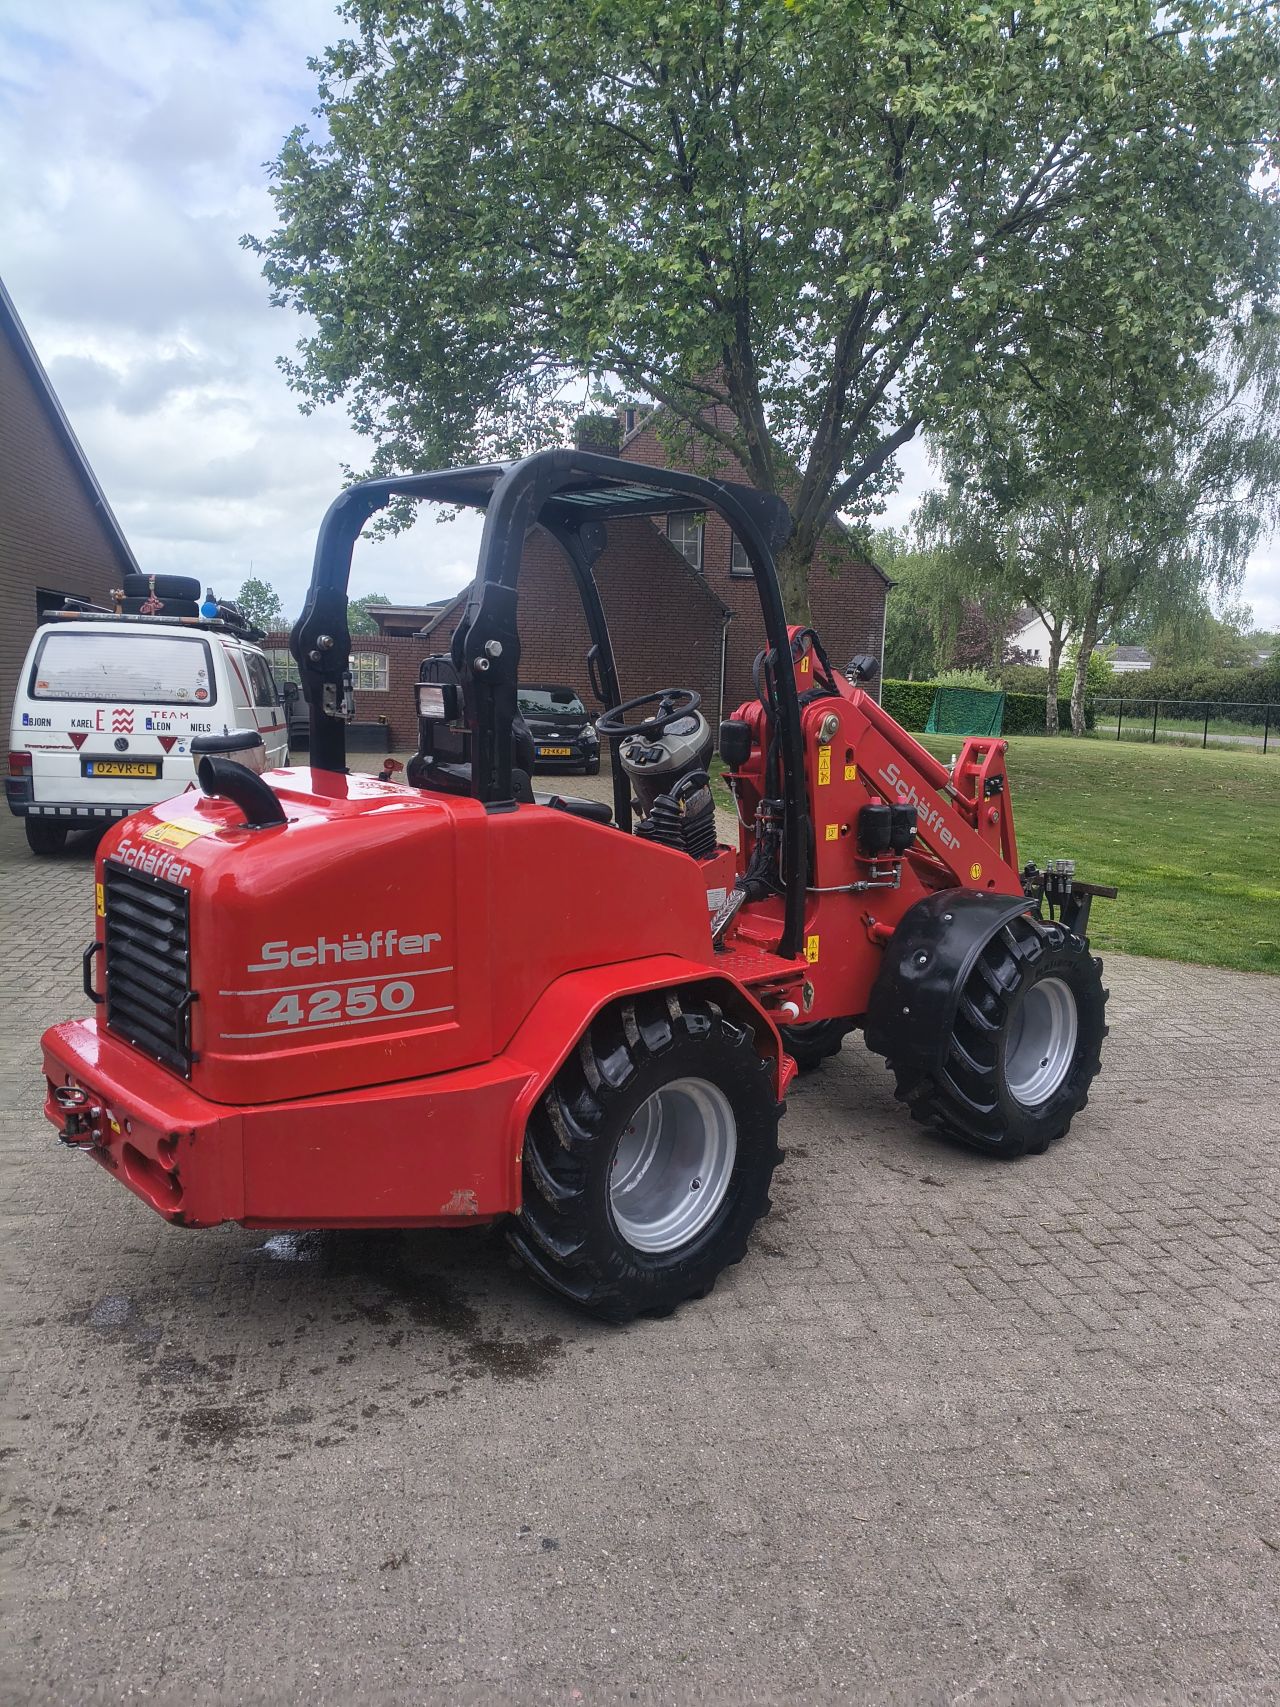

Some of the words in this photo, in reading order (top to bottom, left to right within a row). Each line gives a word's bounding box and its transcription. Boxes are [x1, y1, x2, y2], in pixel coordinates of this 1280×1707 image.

[151, 711, 189, 719] TEAM
[28, 718, 51, 727] BJORN
[71, 719, 94, 728] KAREL
[152, 722, 171, 731] LEON
[190, 724, 211, 732] NIELS
[97, 762, 153, 774] 02-VR-GL
[879, 763, 960, 849] Schäffer
[110, 839, 191, 883] Schäffer
[248, 930, 441, 972] Schäffer
[267, 981, 414, 1025] 4250
